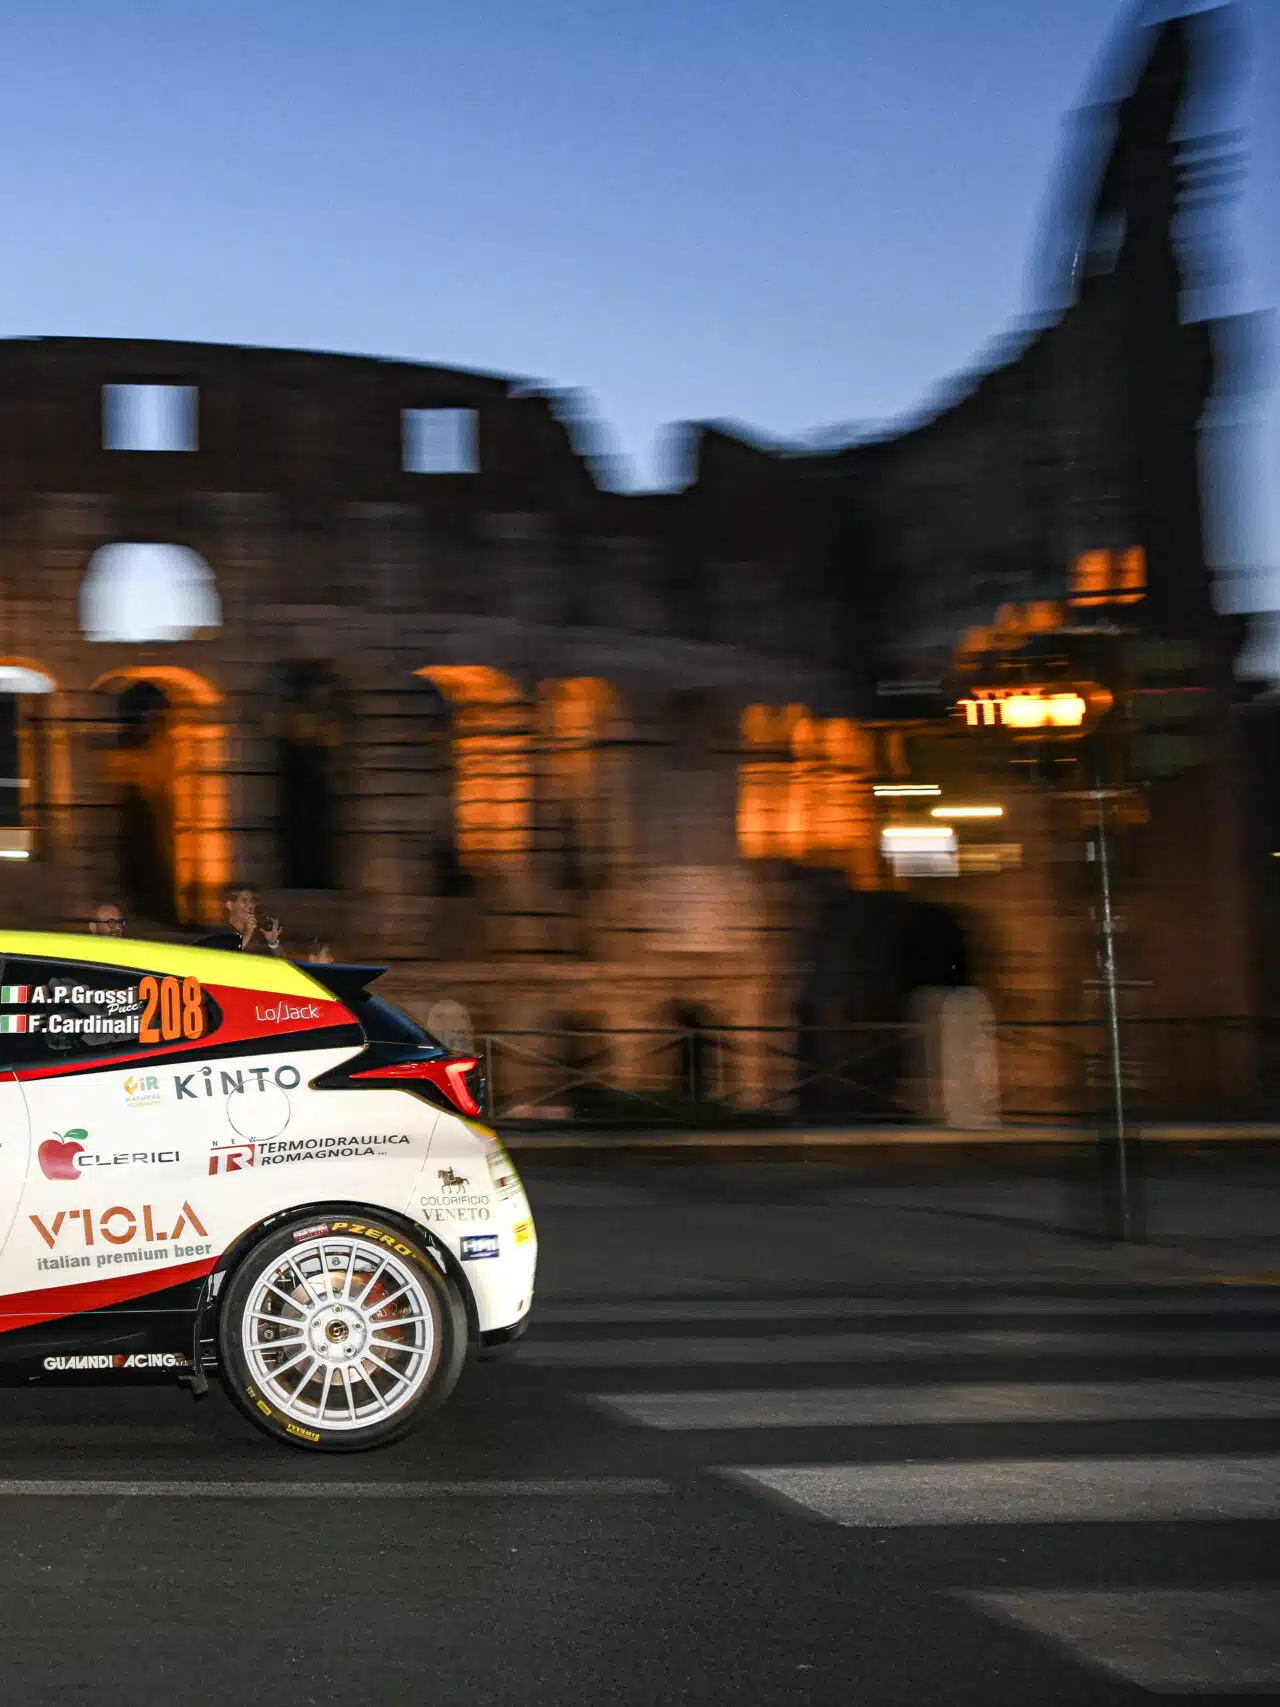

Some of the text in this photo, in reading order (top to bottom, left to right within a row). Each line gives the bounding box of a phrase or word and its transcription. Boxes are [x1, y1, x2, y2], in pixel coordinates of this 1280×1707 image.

[106, 1001, 142, 1016] Pucc
[139, 975, 204, 1043] 208
[28, 1014, 139, 1034] F.Cardinali
[257, 1134, 411, 1155] TERMOIDRAULICA
[78, 1151, 180, 1167] CLERICI
[261, 1147, 375, 1166] ROMAGNOLA
[420, 1195, 489, 1206] COLORIFICIO
[422, 1207, 490, 1221] VENETO
[28, 1200, 209, 1250] VIOLA
[37, 1243, 212, 1271] italian premium beer
[43, 1355, 113, 1370] GUALANDI
